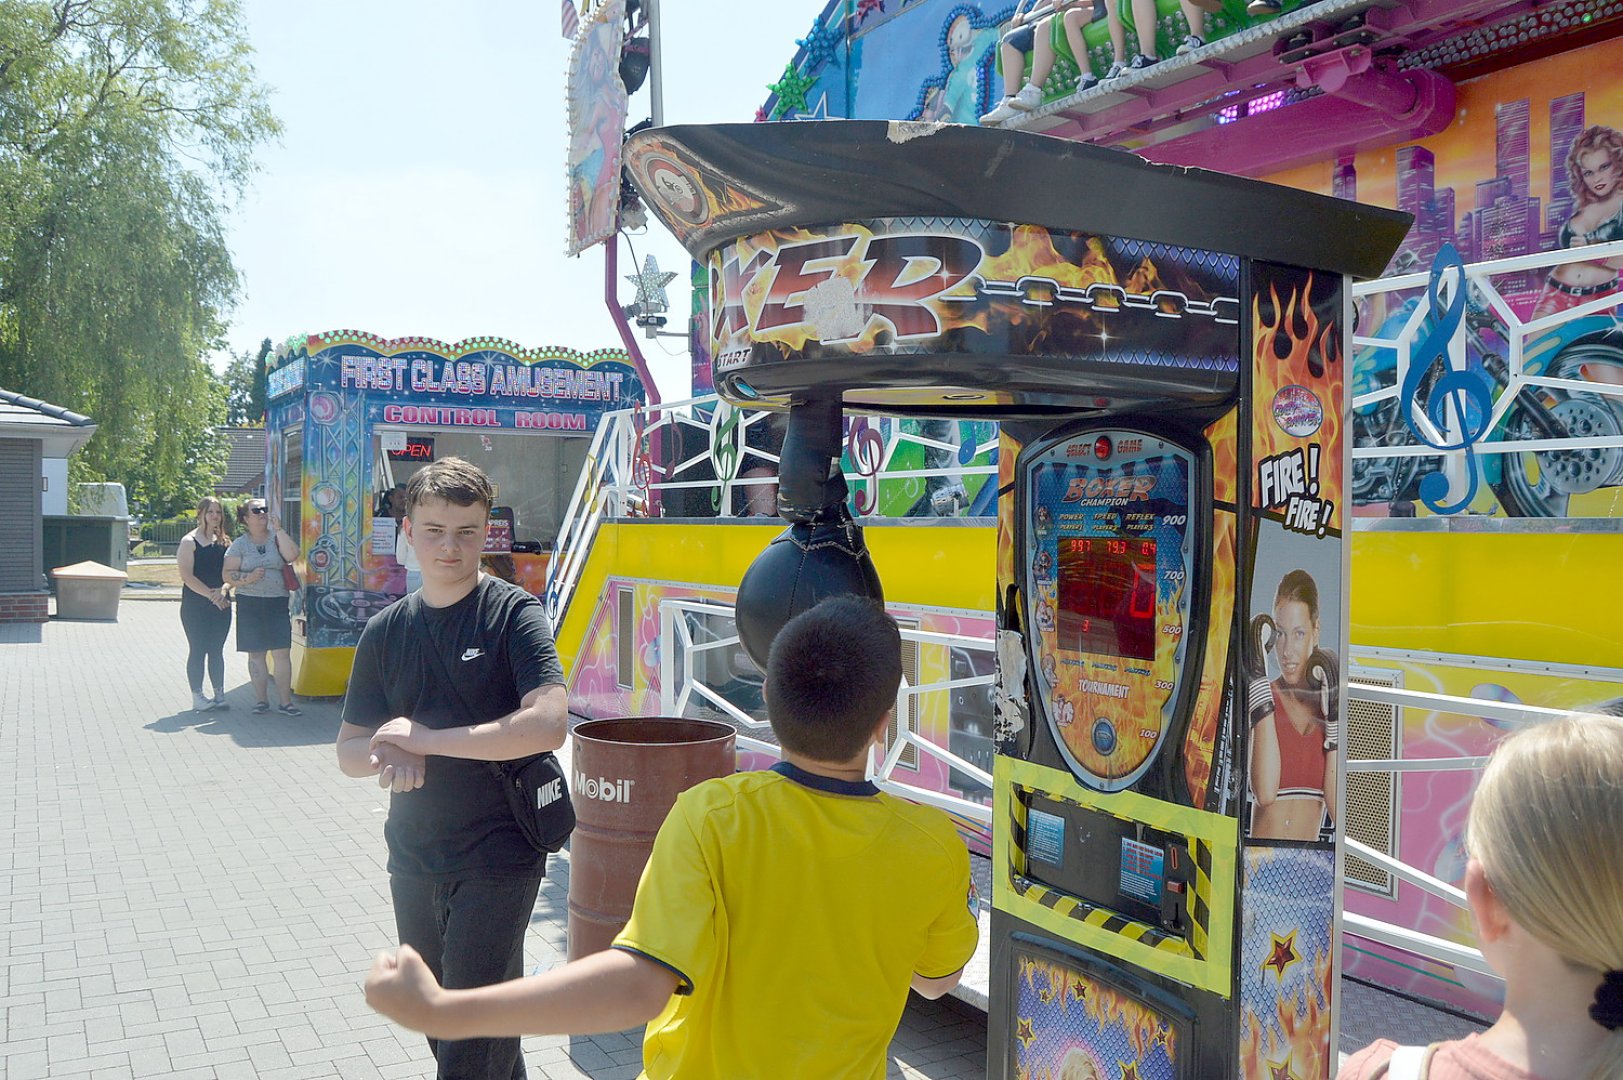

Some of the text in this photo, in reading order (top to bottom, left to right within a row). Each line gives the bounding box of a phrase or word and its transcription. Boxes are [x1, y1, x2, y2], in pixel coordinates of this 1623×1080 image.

[712, 233, 985, 345] XER
[717, 348, 751, 368] START
[341, 355, 408, 390] FIRST
[411, 360, 487, 394] CLASS
[490, 366, 623, 401] AMUSEMENT
[384, 405, 586, 430] CONTROL ROOM
[1259, 446, 1320, 509] FIRE!
[1062, 475, 1157, 503] BOXER
[1080, 498, 1129, 507] CHAMPION
[1162, 515, 1186, 526] 900
[1286, 497, 1332, 535] FIRE!
[1071, 540, 1091, 552] 997
[1163, 570, 1185, 580] 700
[1162, 625, 1182, 635] 500
[1079, 680, 1130, 699] TOURNAMENT
[1154, 680, 1173, 690] 300
[1139, 729, 1157, 739] 100
[537, 777, 562, 809] NIKE
[575, 770, 631, 803] Mobil
